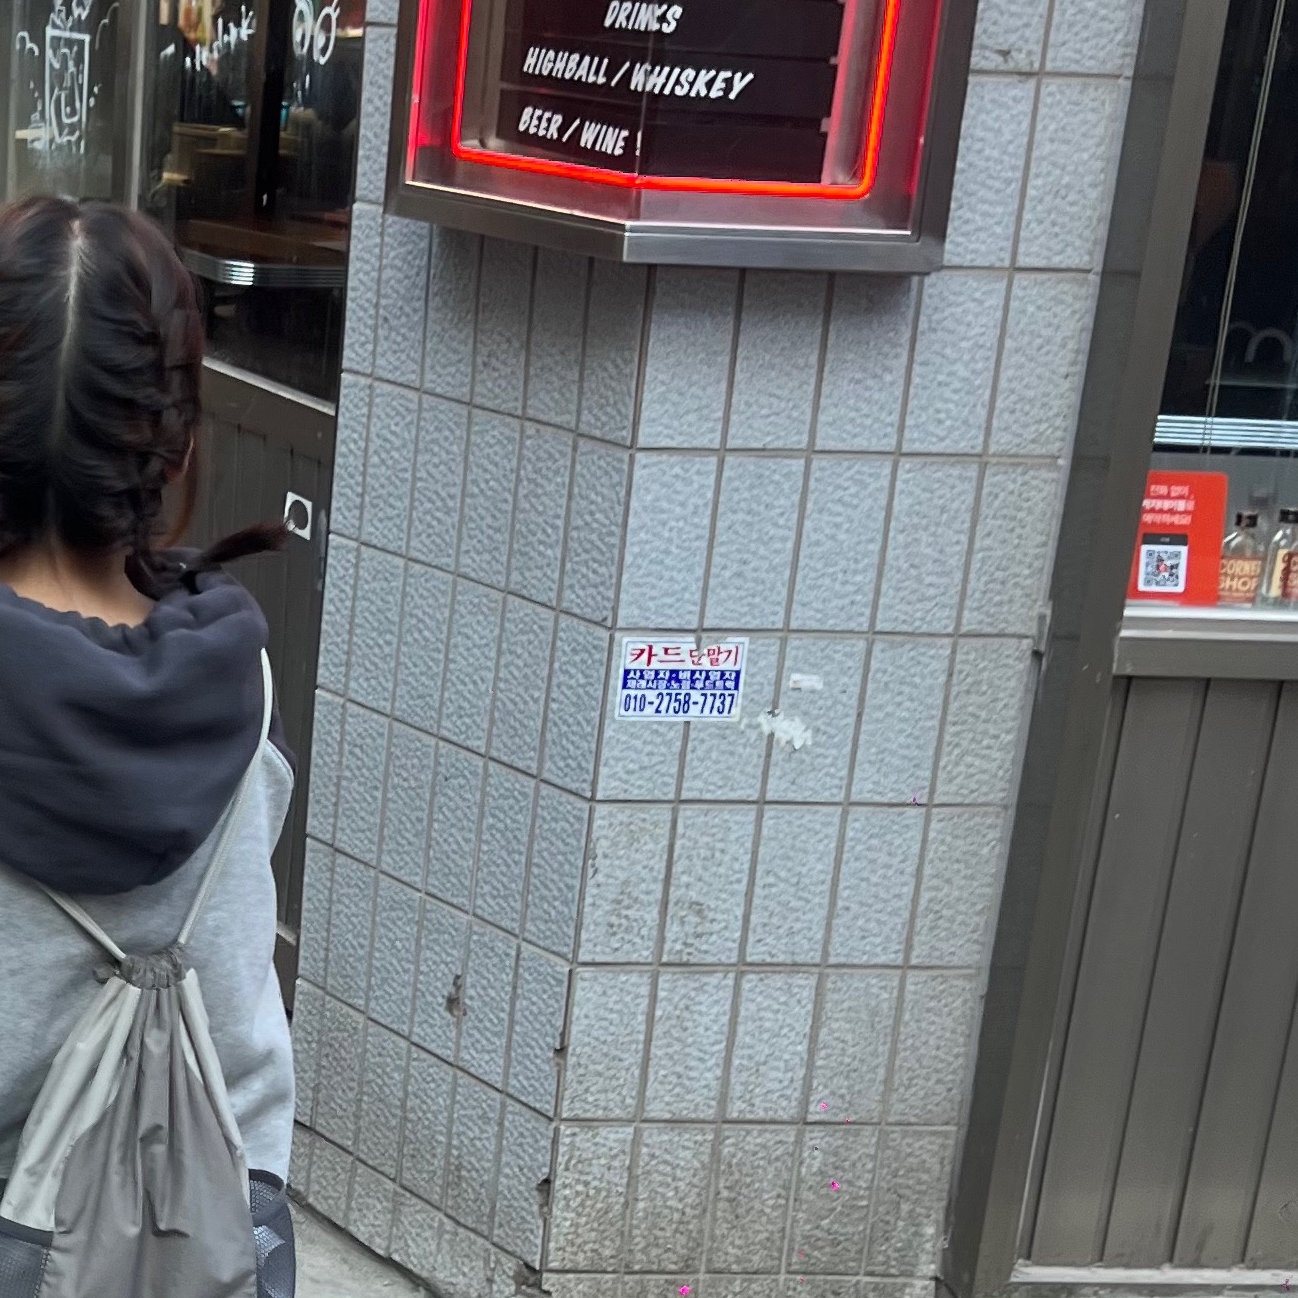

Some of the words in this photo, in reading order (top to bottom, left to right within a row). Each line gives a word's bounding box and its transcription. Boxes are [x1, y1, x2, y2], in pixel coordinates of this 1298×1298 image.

[603, 0, 684, 34] DRINKS
[522, 46, 609, 86] HIGHBALL
[629, 60, 755, 101] WHISKEY
[518, 105, 563, 141] BEER
[580, 119, 630, 157] WINE
[623, 692, 736, 715] 010-2758-7737
